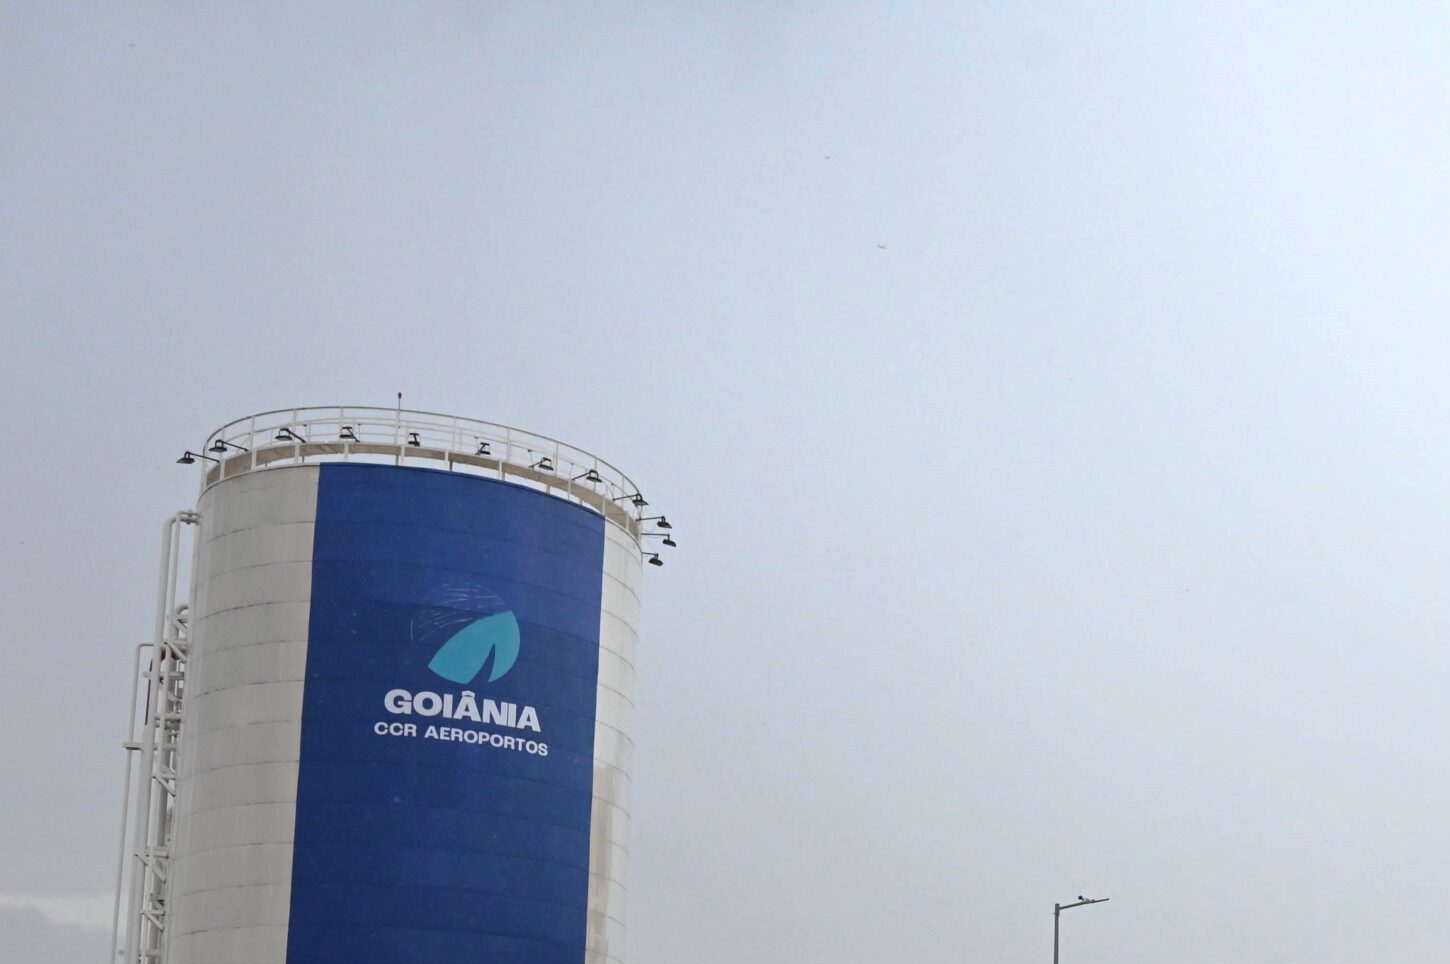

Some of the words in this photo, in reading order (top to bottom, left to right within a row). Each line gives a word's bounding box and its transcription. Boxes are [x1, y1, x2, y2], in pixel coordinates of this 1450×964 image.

[384, 689, 541, 732] GOIÂNIA
[374, 721, 417, 737] CCR
[424, 725, 548, 756] AEROPORTOS
